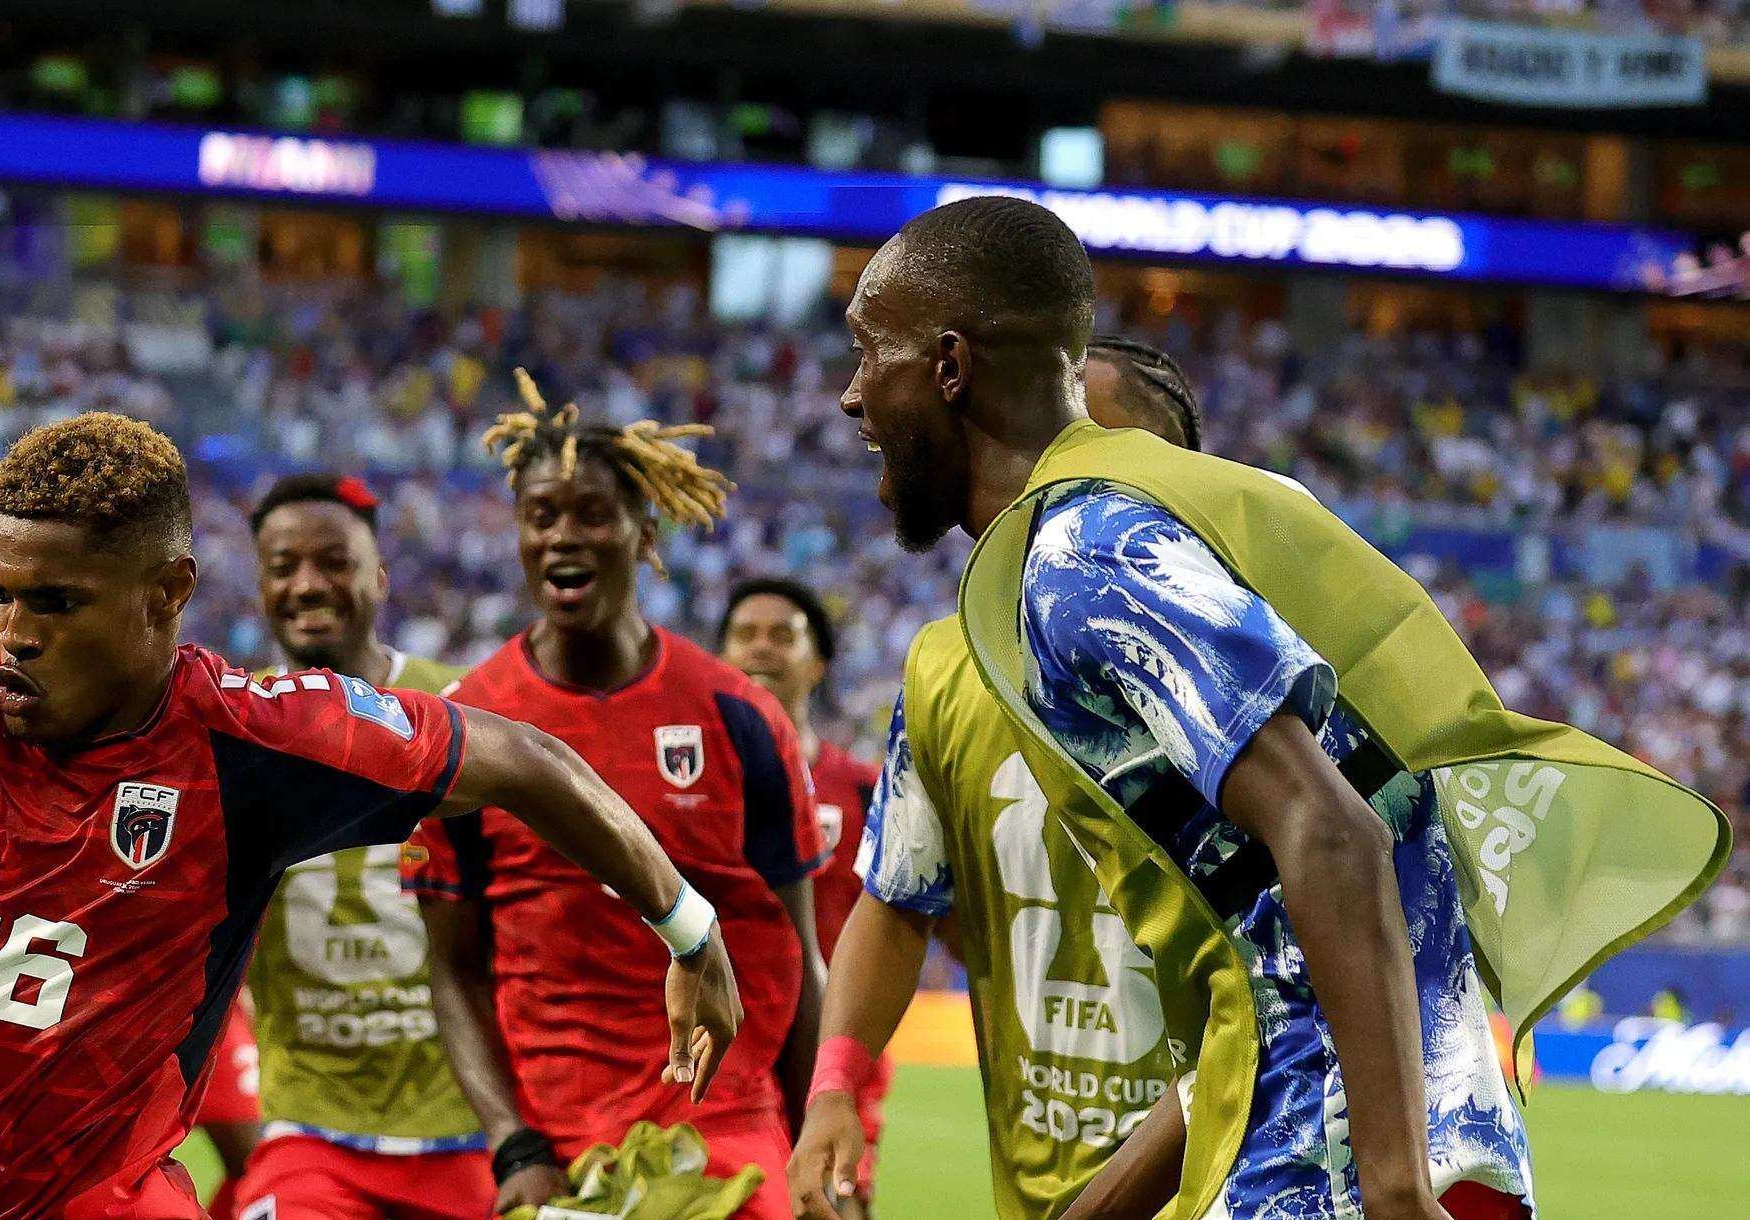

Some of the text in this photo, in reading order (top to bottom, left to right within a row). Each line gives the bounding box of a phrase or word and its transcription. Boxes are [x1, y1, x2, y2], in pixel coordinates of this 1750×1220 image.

[122, 786, 175, 802] FCF
[1045, 996, 1118, 1034] FIFA
[1104, 1074, 1168, 1105] CUP
